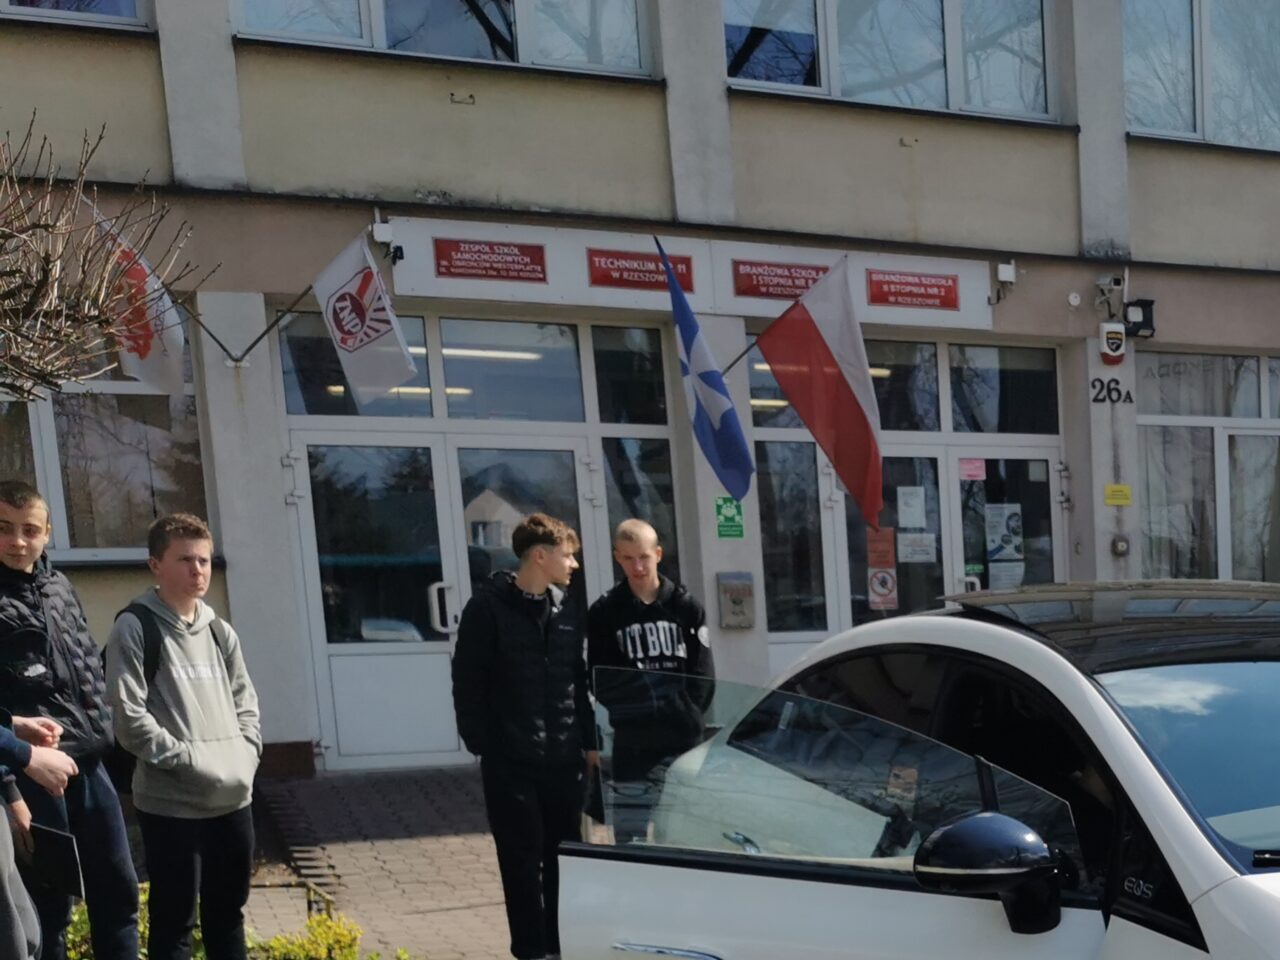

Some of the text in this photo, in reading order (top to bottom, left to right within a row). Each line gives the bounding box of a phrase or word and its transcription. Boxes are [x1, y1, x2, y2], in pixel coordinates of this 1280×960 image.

[451, 252, 531, 264] SAMOCHODOWYCH
[593, 257, 656, 271] TECHNIKUM
[677, 264, 686, 273] 11
[739, 264, 790, 276] BRANŻOWA
[611, 271, 668, 282] W RZESZOWI
[758, 275, 793, 286] STOPNIA
[890, 285, 925, 294] STOPNIA
[334, 294, 362, 333] ZNP
[1124, 876, 1154, 899] EQS
